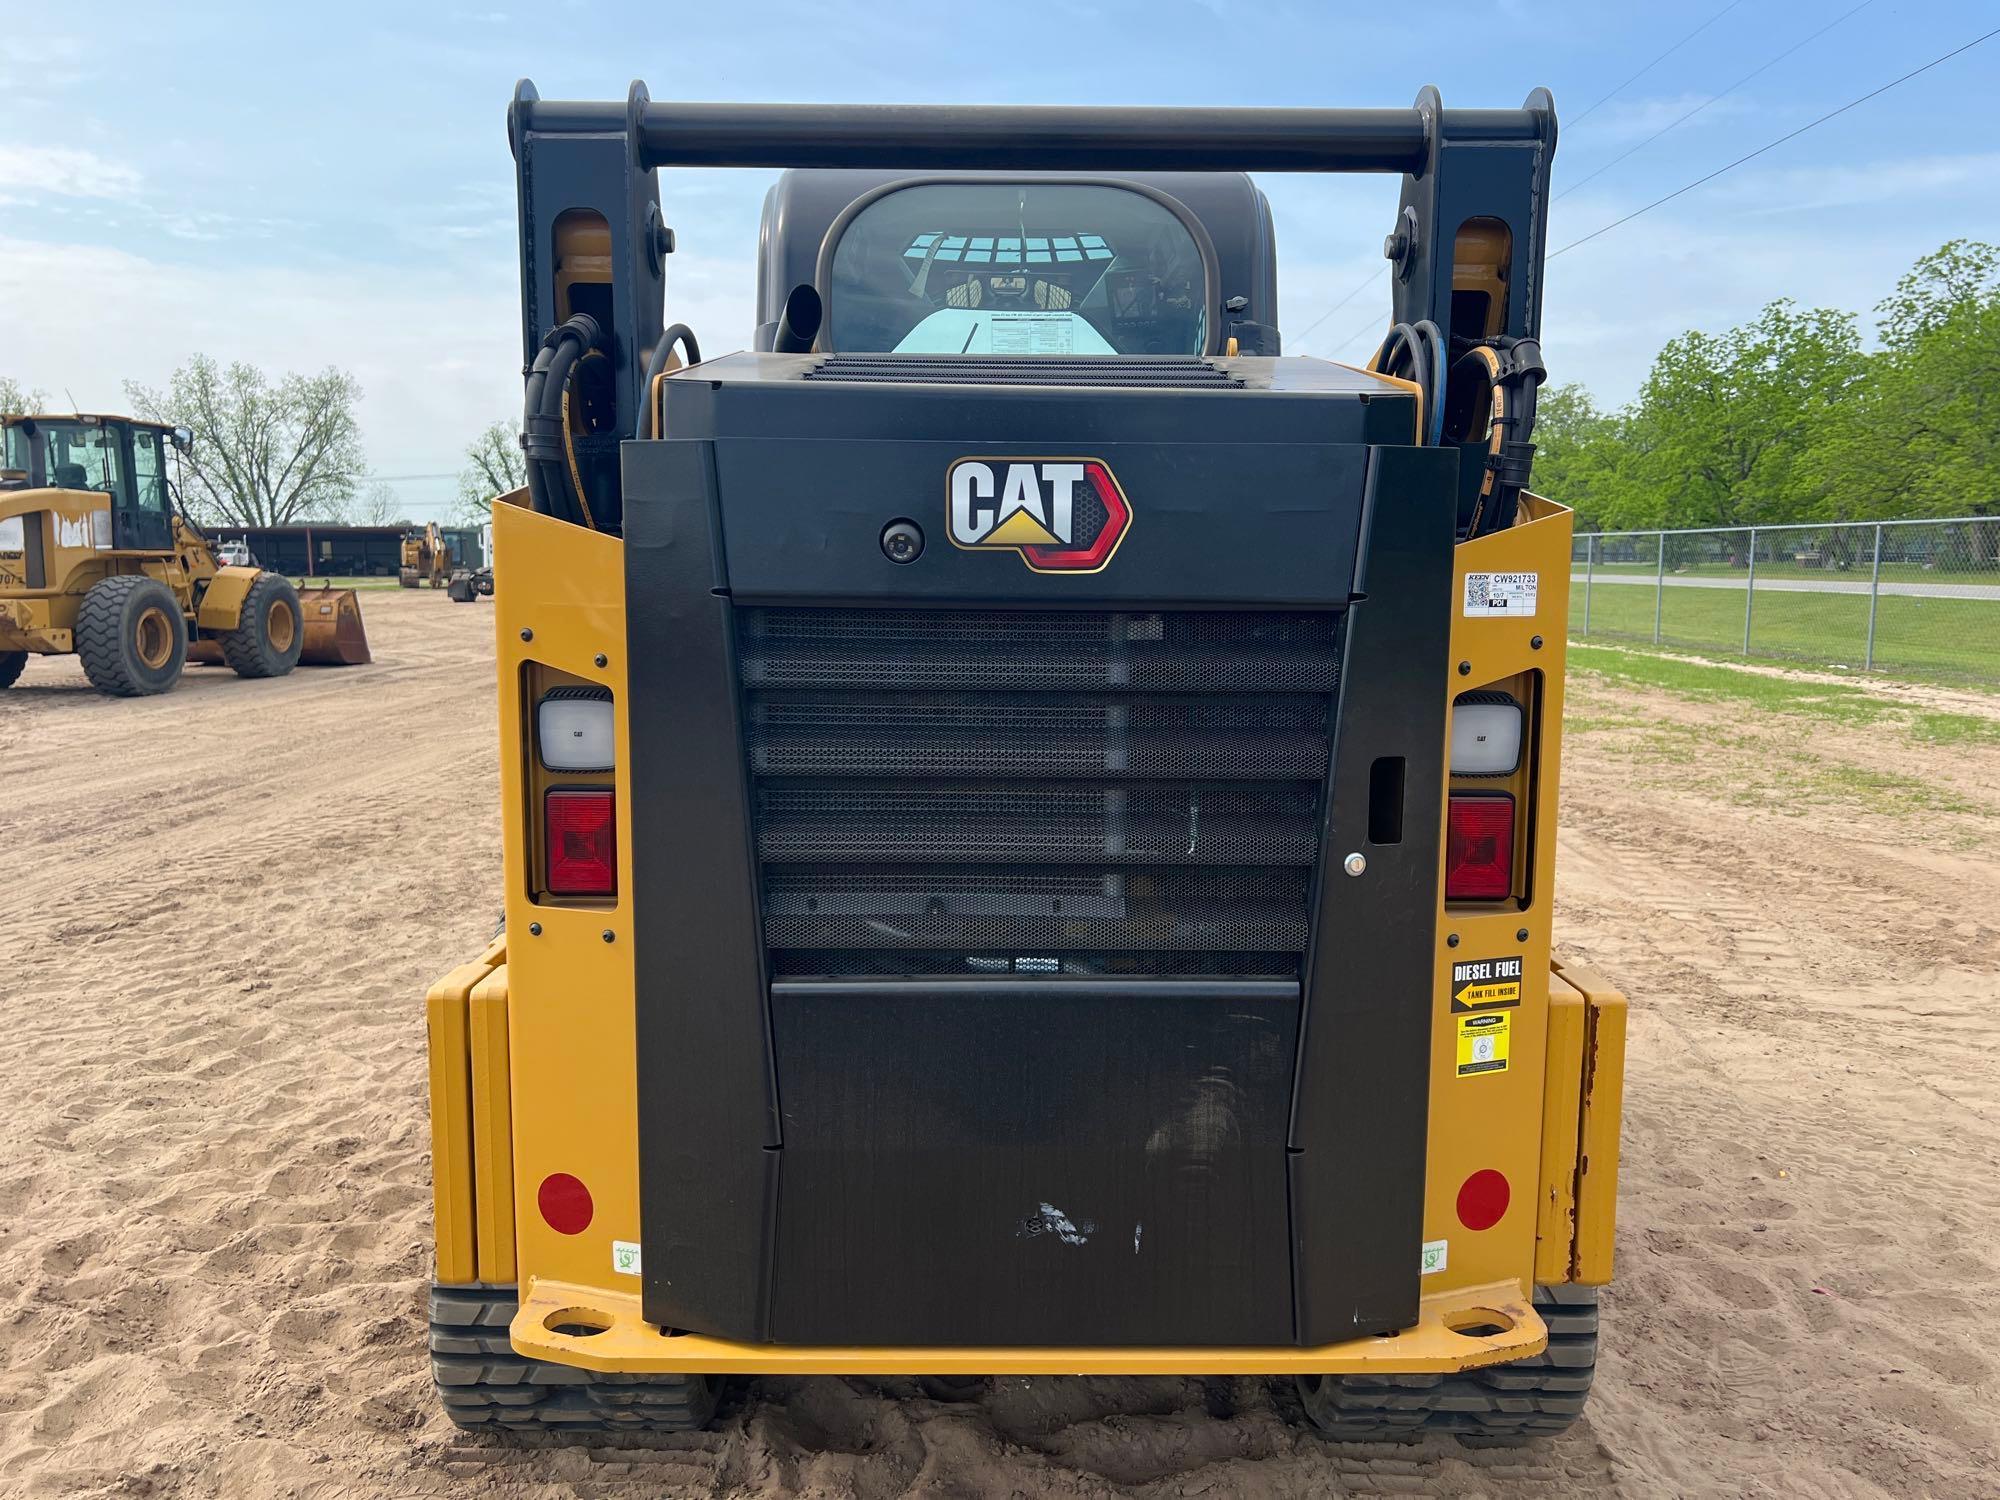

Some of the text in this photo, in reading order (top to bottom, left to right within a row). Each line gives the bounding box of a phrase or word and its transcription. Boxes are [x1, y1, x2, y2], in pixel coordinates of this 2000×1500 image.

[952, 462, 1084, 544] CAT
[1494, 574, 1536, 583] CW921733
[1492, 599, 1504, 607] PDI
[1454, 960, 1521, 982] DIESEL FUEL
[1467, 987, 1516, 1000] TANK FILL INSIDE
[1472, 1017, 1497, 1026] WARNING
